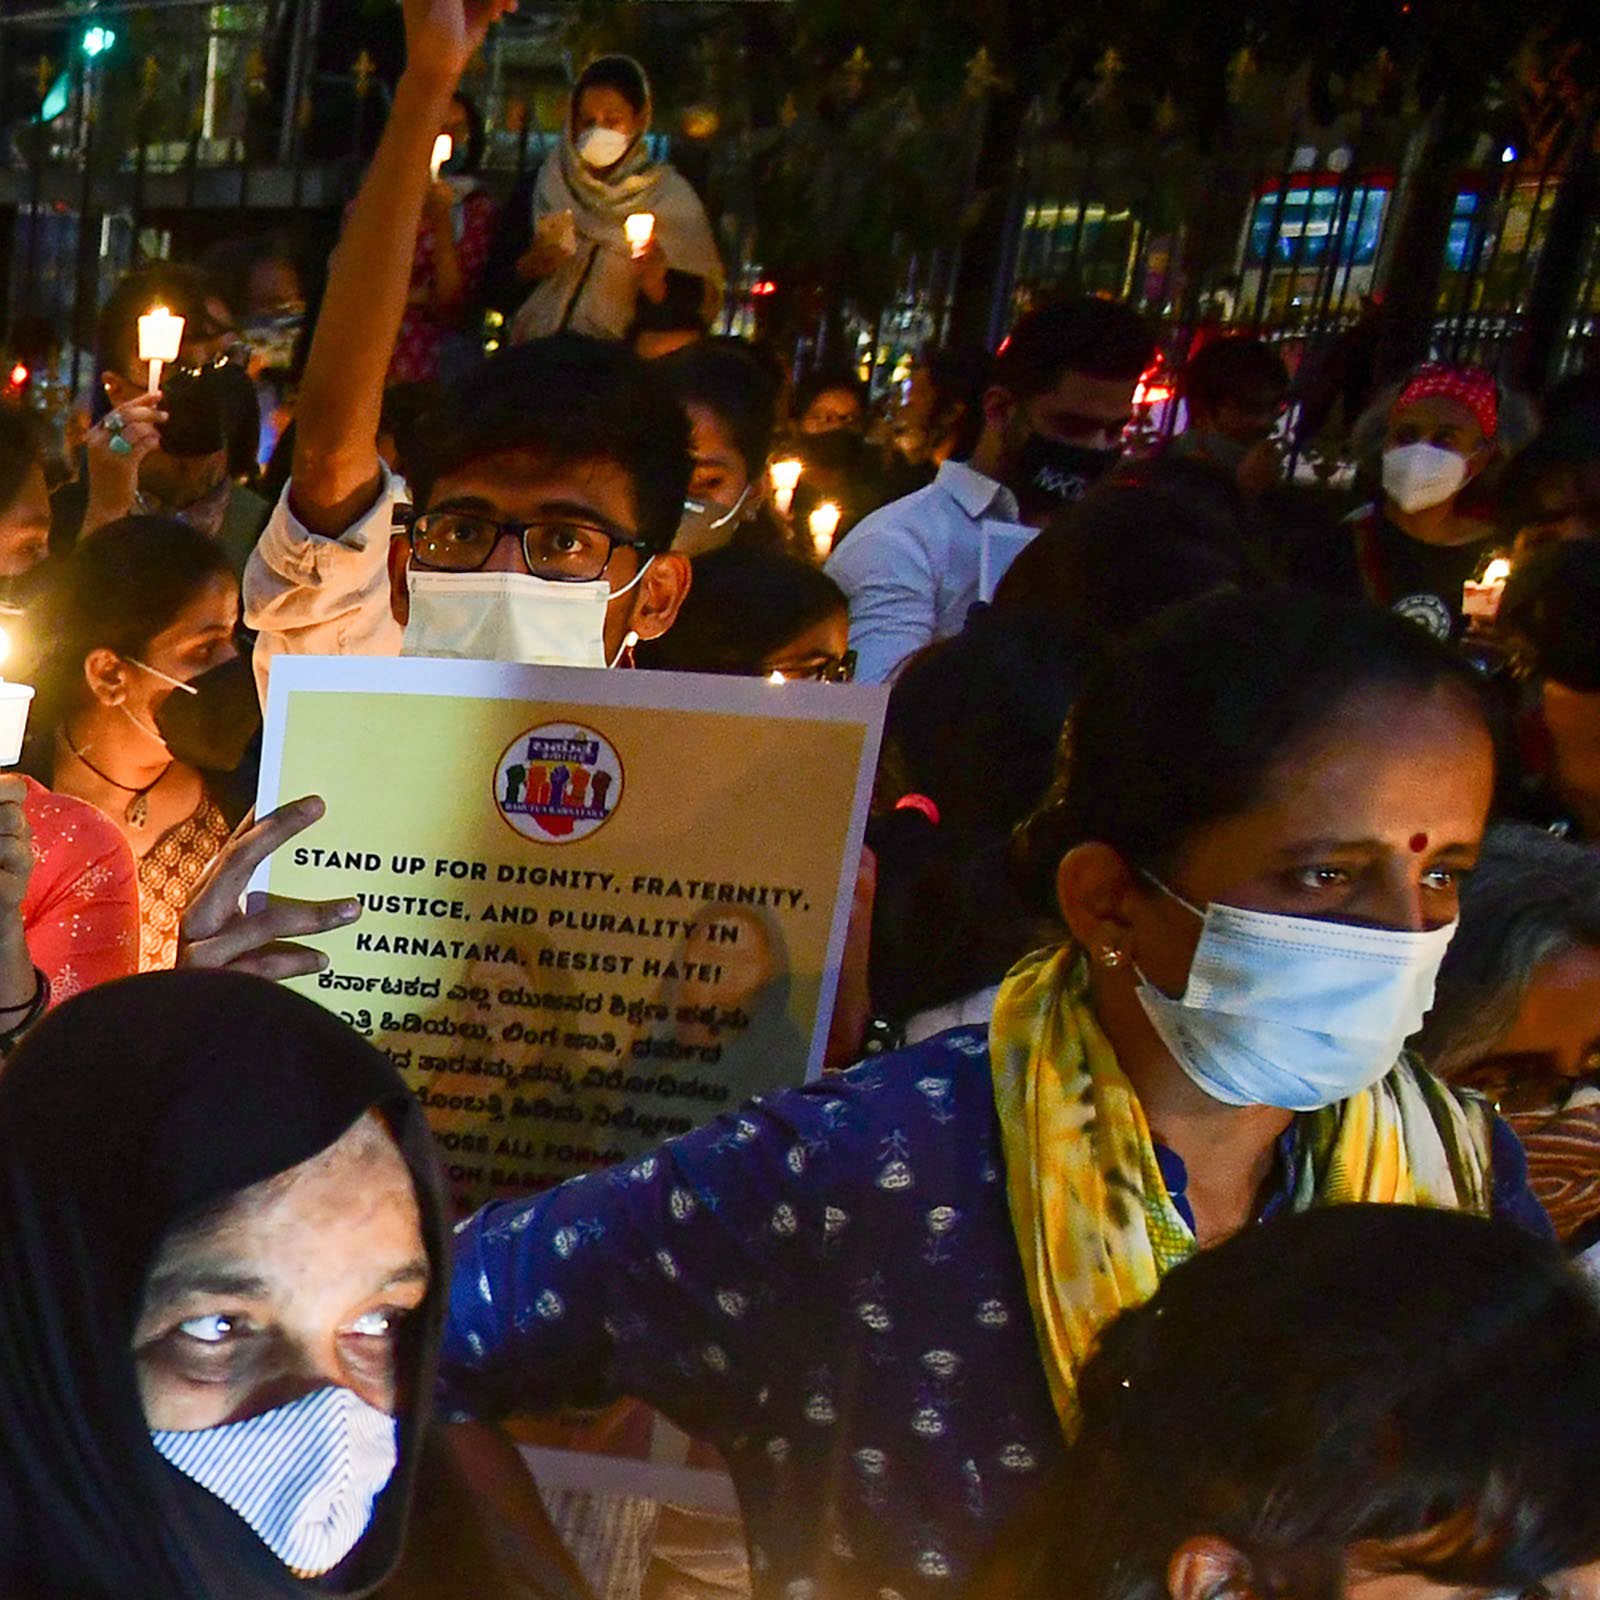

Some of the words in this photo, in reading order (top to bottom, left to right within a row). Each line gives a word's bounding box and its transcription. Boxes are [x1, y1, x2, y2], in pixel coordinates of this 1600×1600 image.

[293, 847, 383, 874] STAND
[391, 855, 427, 877] UP
[434, 859, 488, 882] FOR
[481, 903, 539, 927] AND
[548, 910, 699, 940] PLURALITY
[706, 924, 740, 944] IN
[537, 949, 634, 976] RESIST
[643, 959, 723, 985] HATE!
